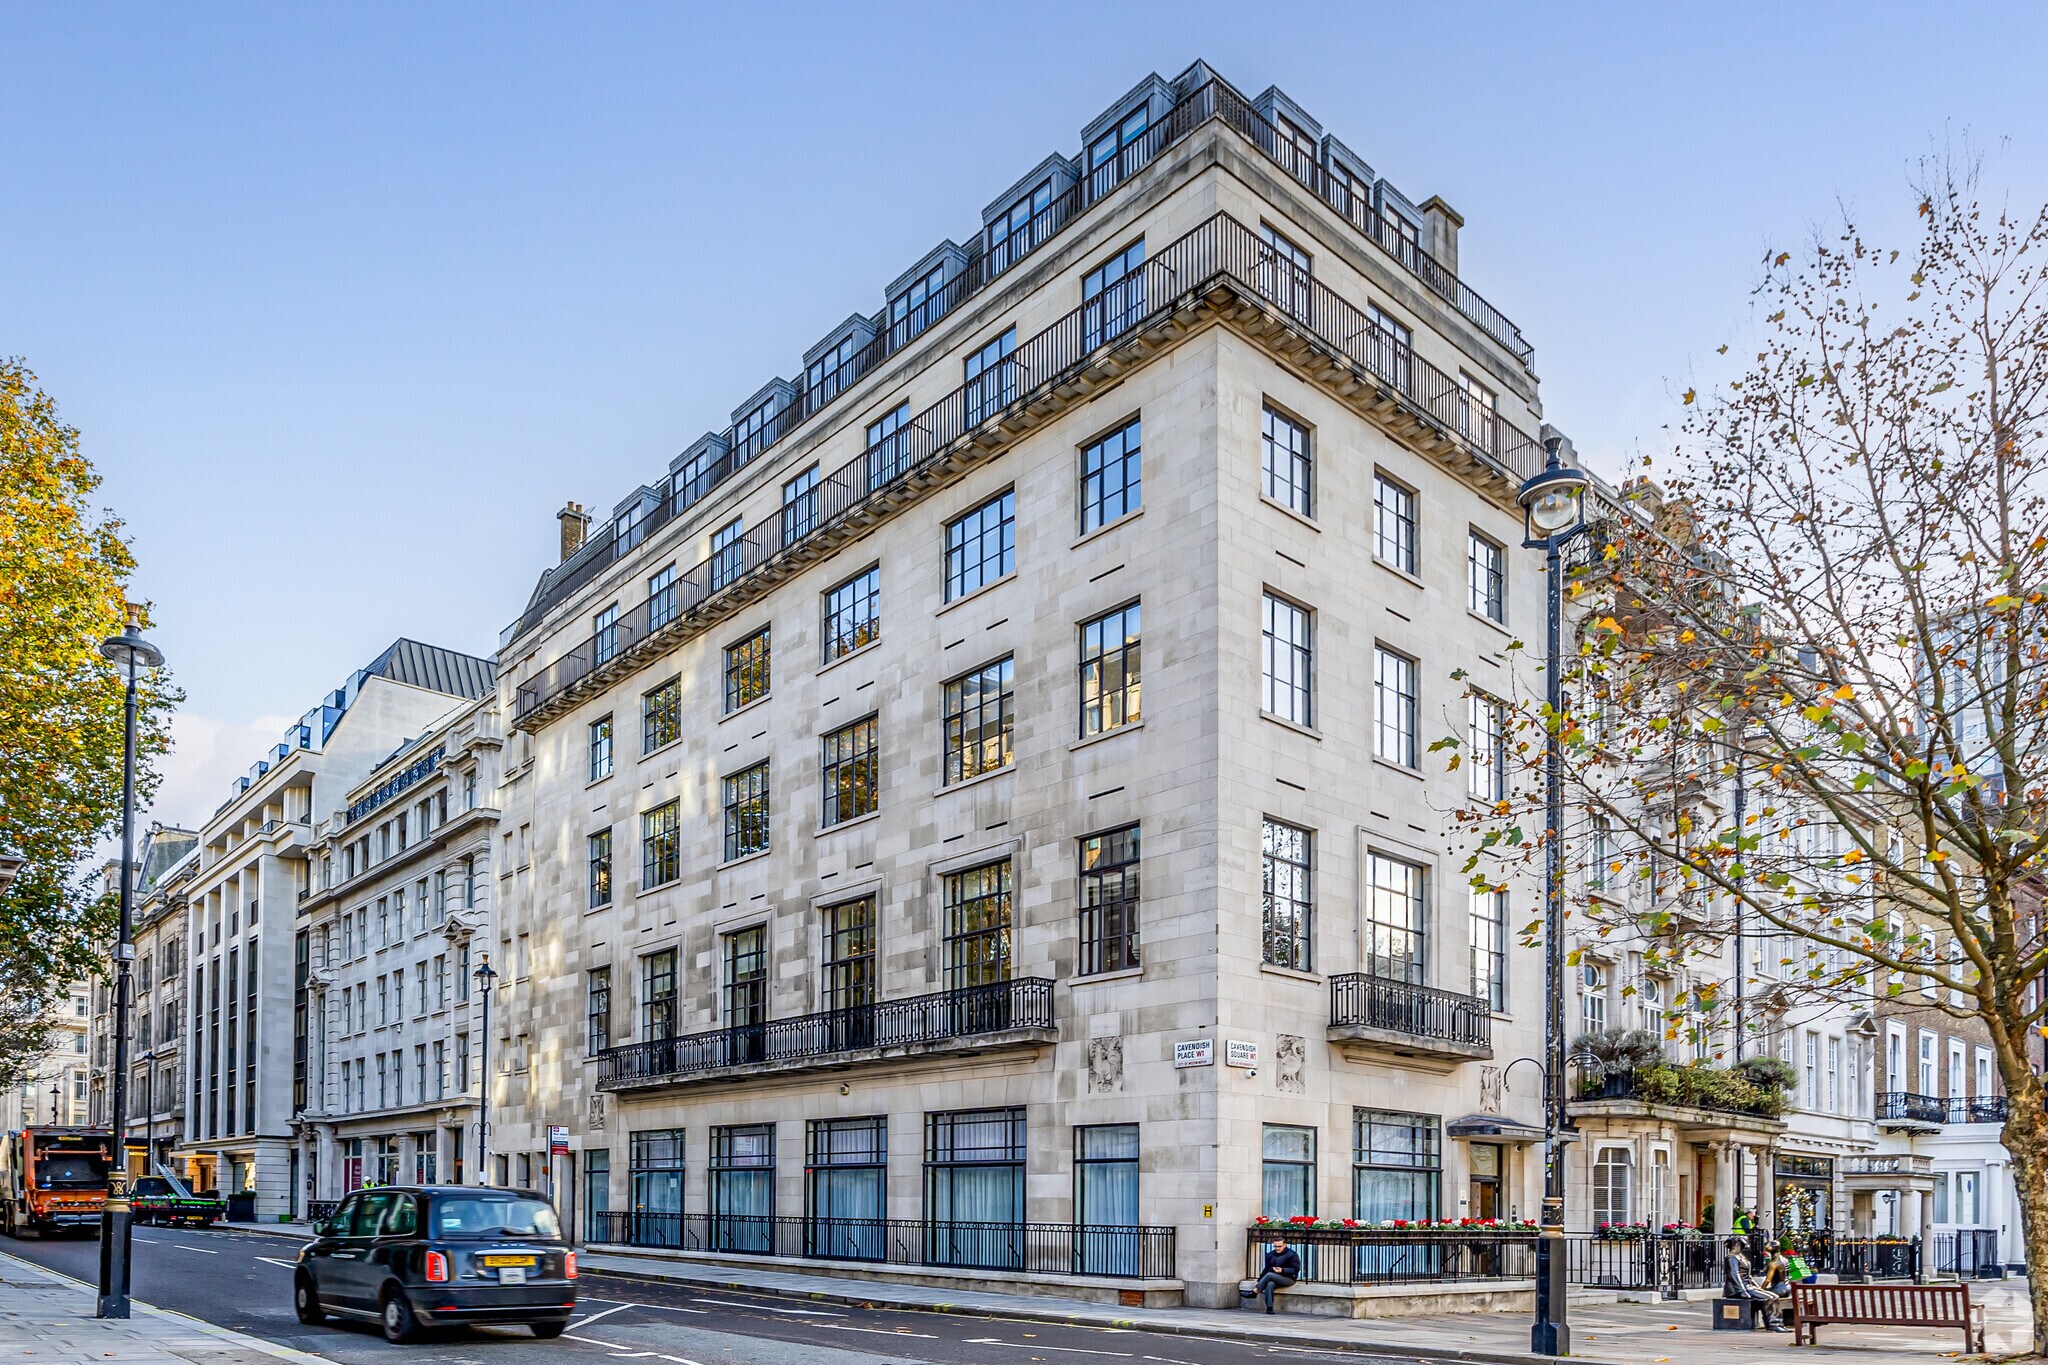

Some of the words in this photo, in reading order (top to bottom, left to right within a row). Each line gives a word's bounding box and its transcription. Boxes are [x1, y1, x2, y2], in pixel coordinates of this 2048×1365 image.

[1178, 1042, 1210, 1052] CAVENDISH
[1230, 1043, 1256, 1052] CAVENDISH
[1178, 1051, 1194, 1059] PLACE
[1230, 1051, 1248, 1060] SQUARE
[1205, 1206, 1212, 1216] H
